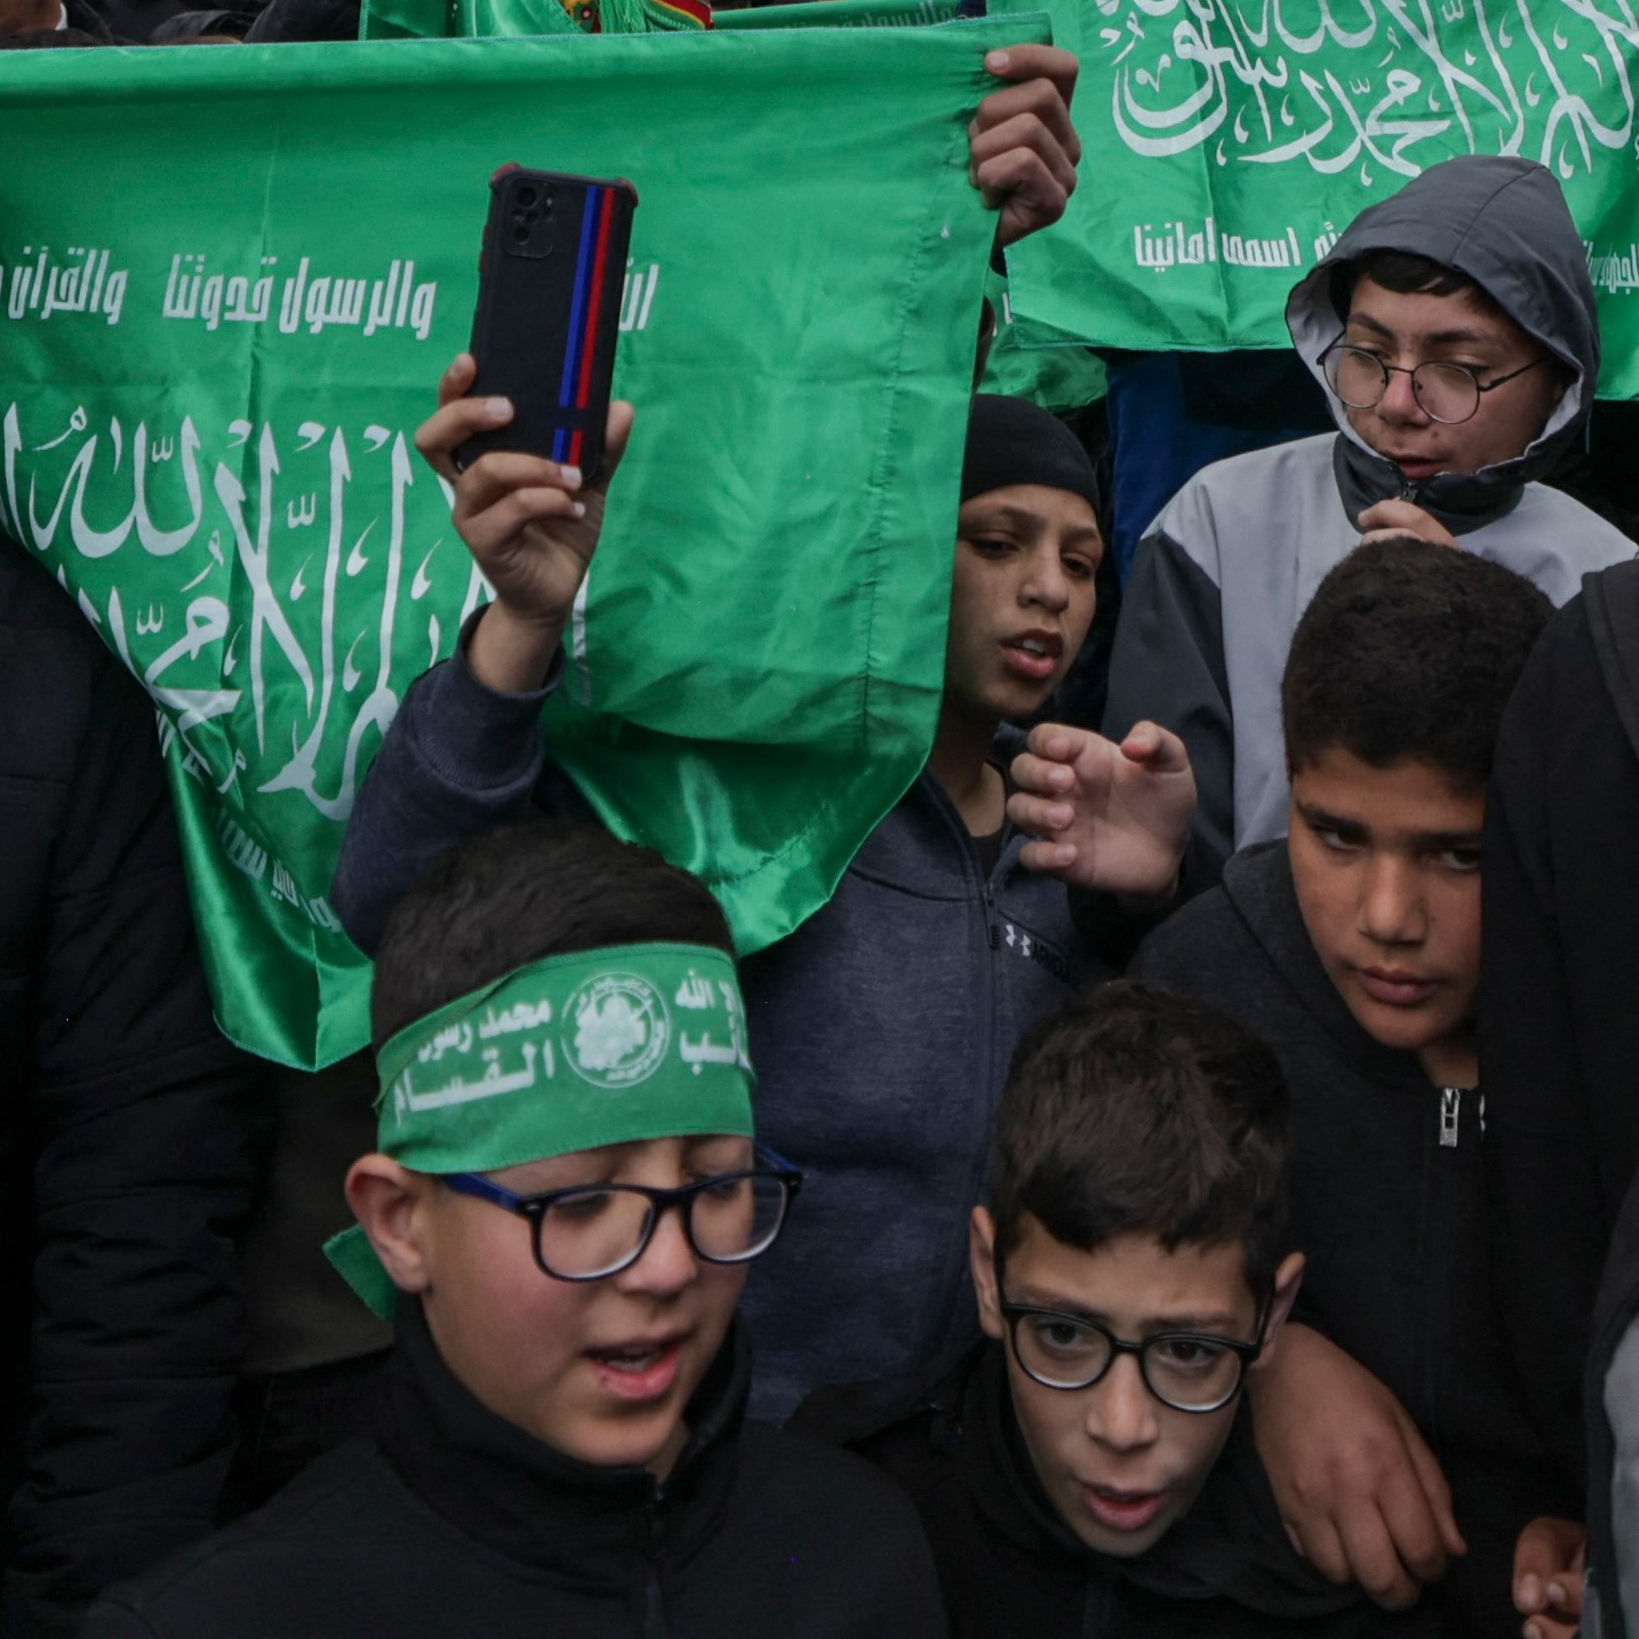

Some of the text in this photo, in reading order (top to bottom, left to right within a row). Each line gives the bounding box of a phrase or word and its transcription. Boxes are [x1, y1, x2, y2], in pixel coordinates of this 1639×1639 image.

[161, 253, 437, 341] والرسول قدوتنا
[479, 997, 552, 1041] محمد
[393, 1037, 555, 1129] القسام
